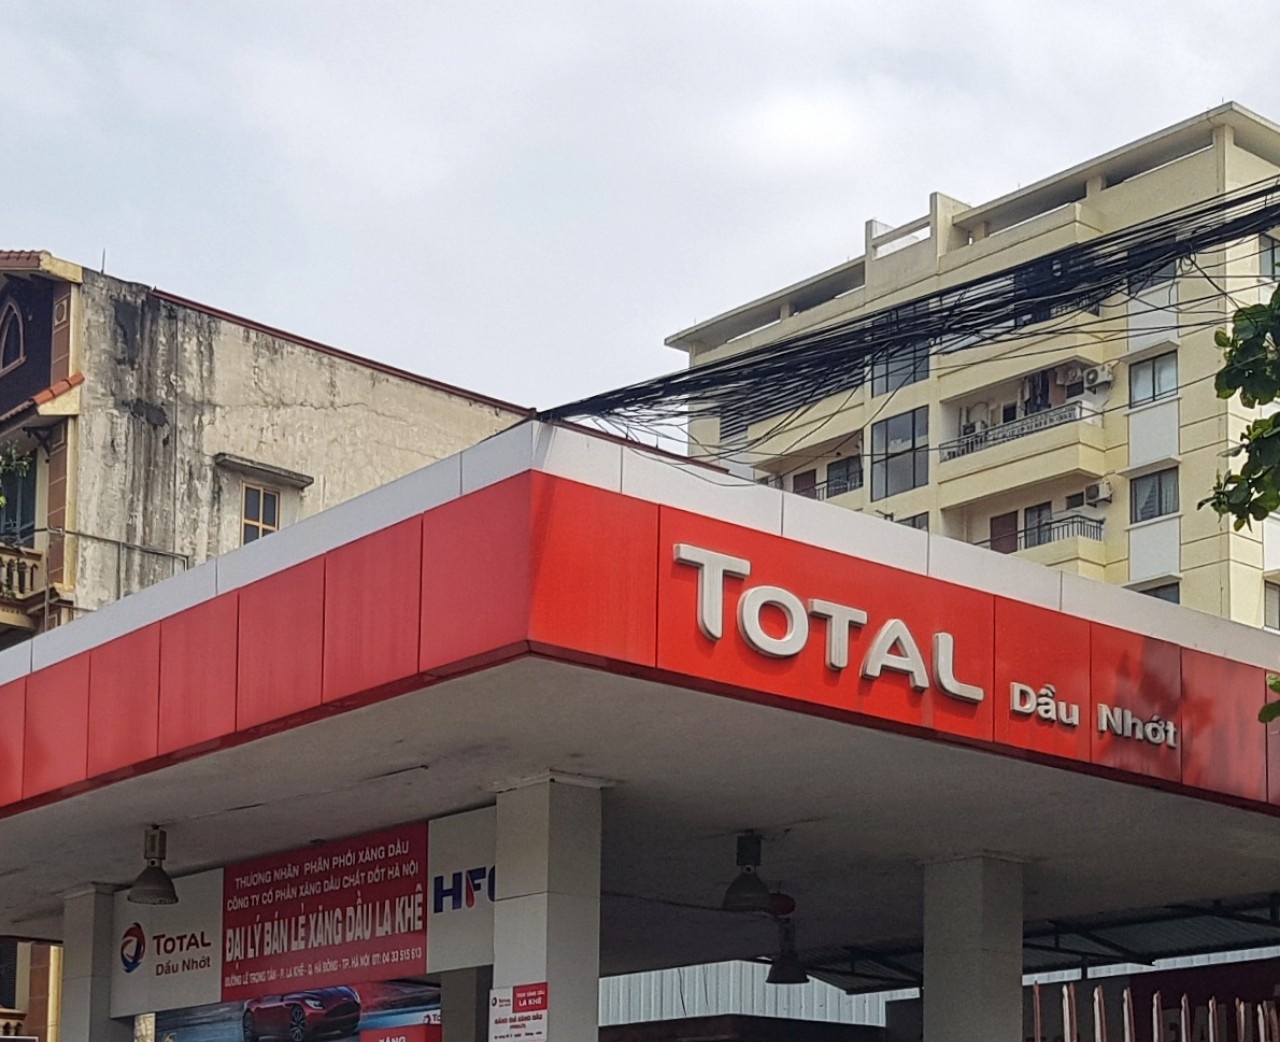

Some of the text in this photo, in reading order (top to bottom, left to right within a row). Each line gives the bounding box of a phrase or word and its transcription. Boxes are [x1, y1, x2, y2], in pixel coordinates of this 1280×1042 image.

[673, 543, 985, 703] TOTAL
[1010, 682, 1178, 748] Dầu Nhớt
[358, 846, 385, 863] XĂNG
[250, 893, 260, 906] TY
[152, 931, 211, 956] TOTAL
[225, 926, 245, 970] ĐẠI
[247, 914, 261, 958] LÝ
[263, 911, 288, 956] BÁN
[308, 905, 342, 949] XĂNG
[345, 890, 372, 942] DẦU
[375, 899, 391, 937] LA
[395, 883, 423, 934] KHÊ
